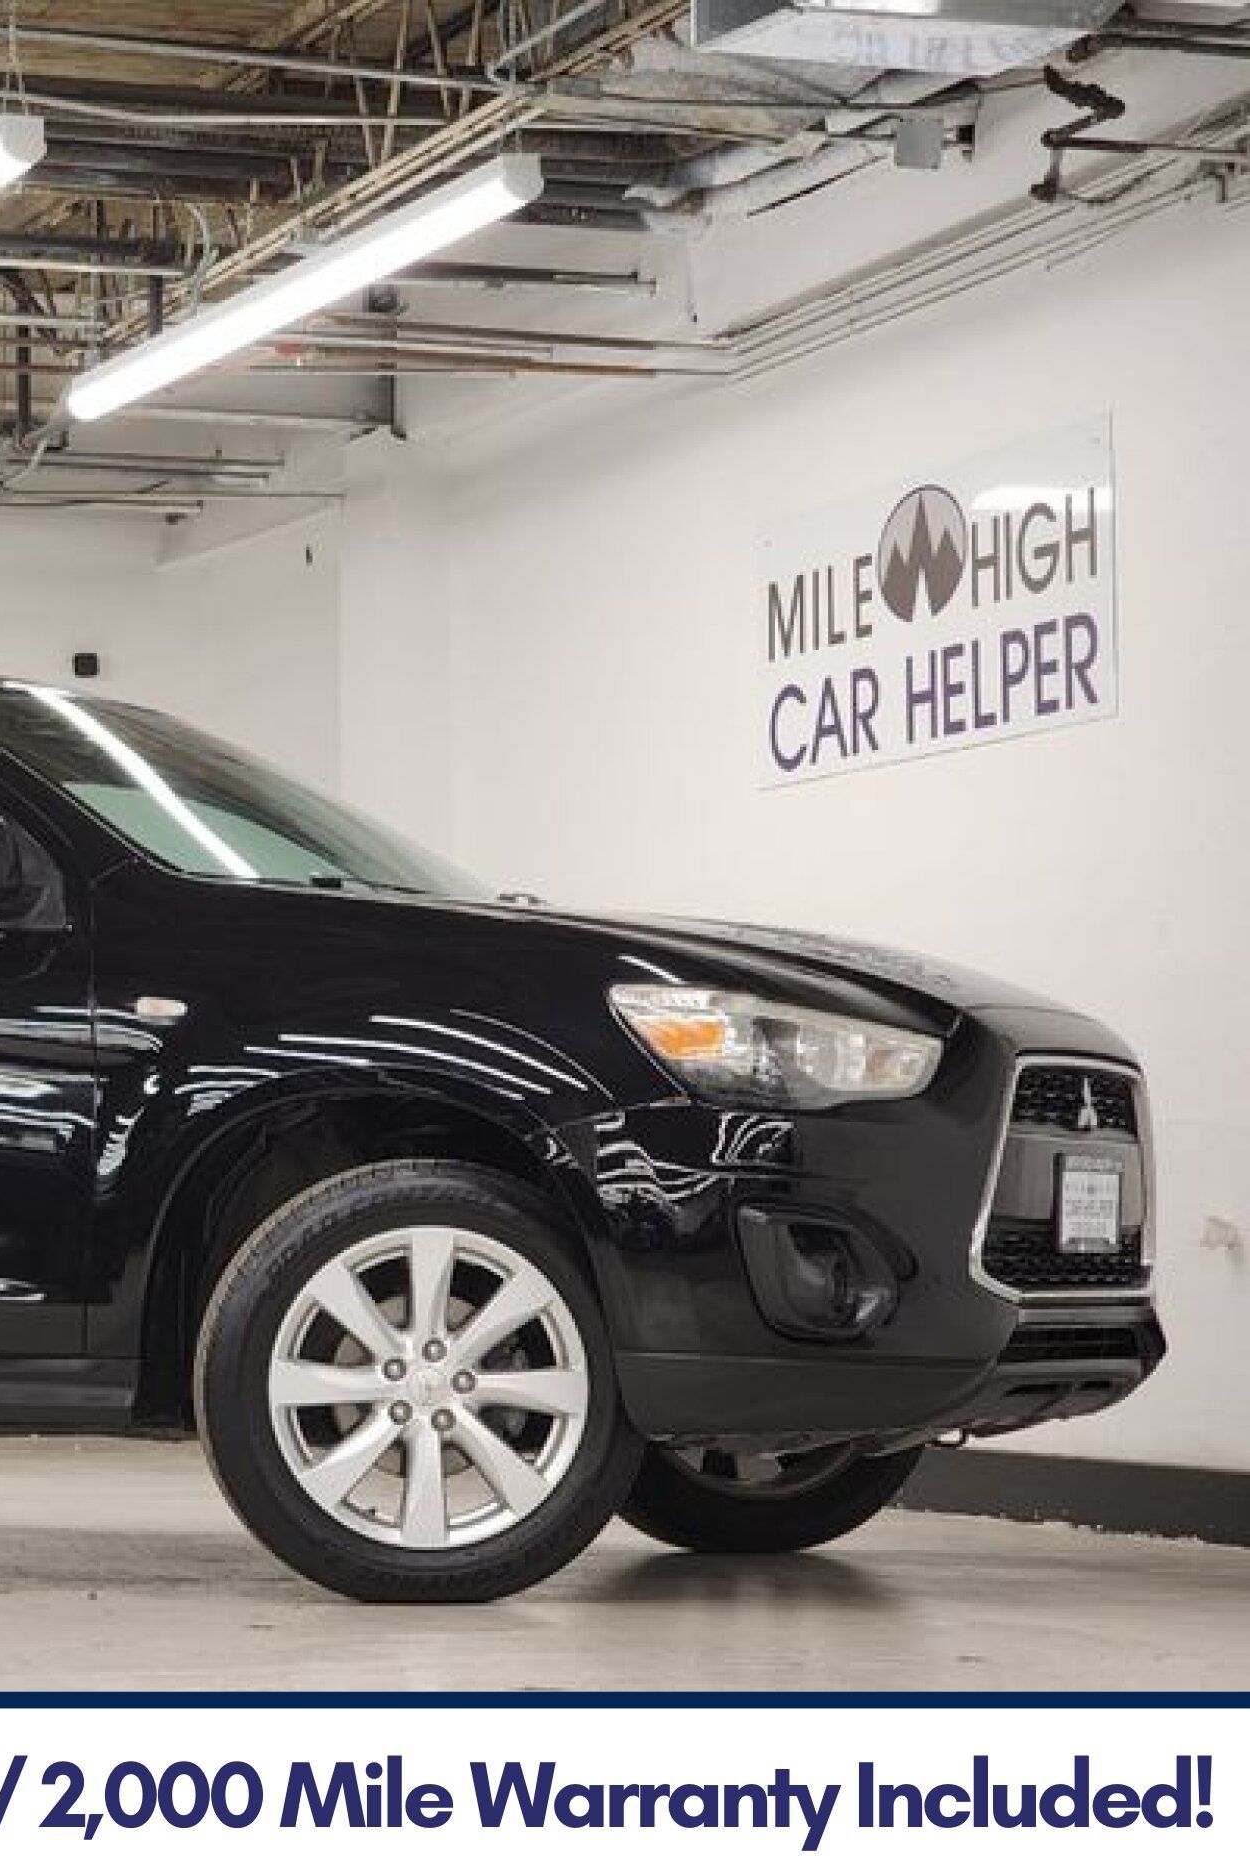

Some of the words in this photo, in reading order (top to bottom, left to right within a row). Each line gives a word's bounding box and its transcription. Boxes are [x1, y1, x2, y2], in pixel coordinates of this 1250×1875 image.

[768, 553, 873, 663] MILE
[971, 486, 1098, 608] HIGH
[770, 667, 880, 772] CAR
[905, 612, 1099, 744] HELPER
